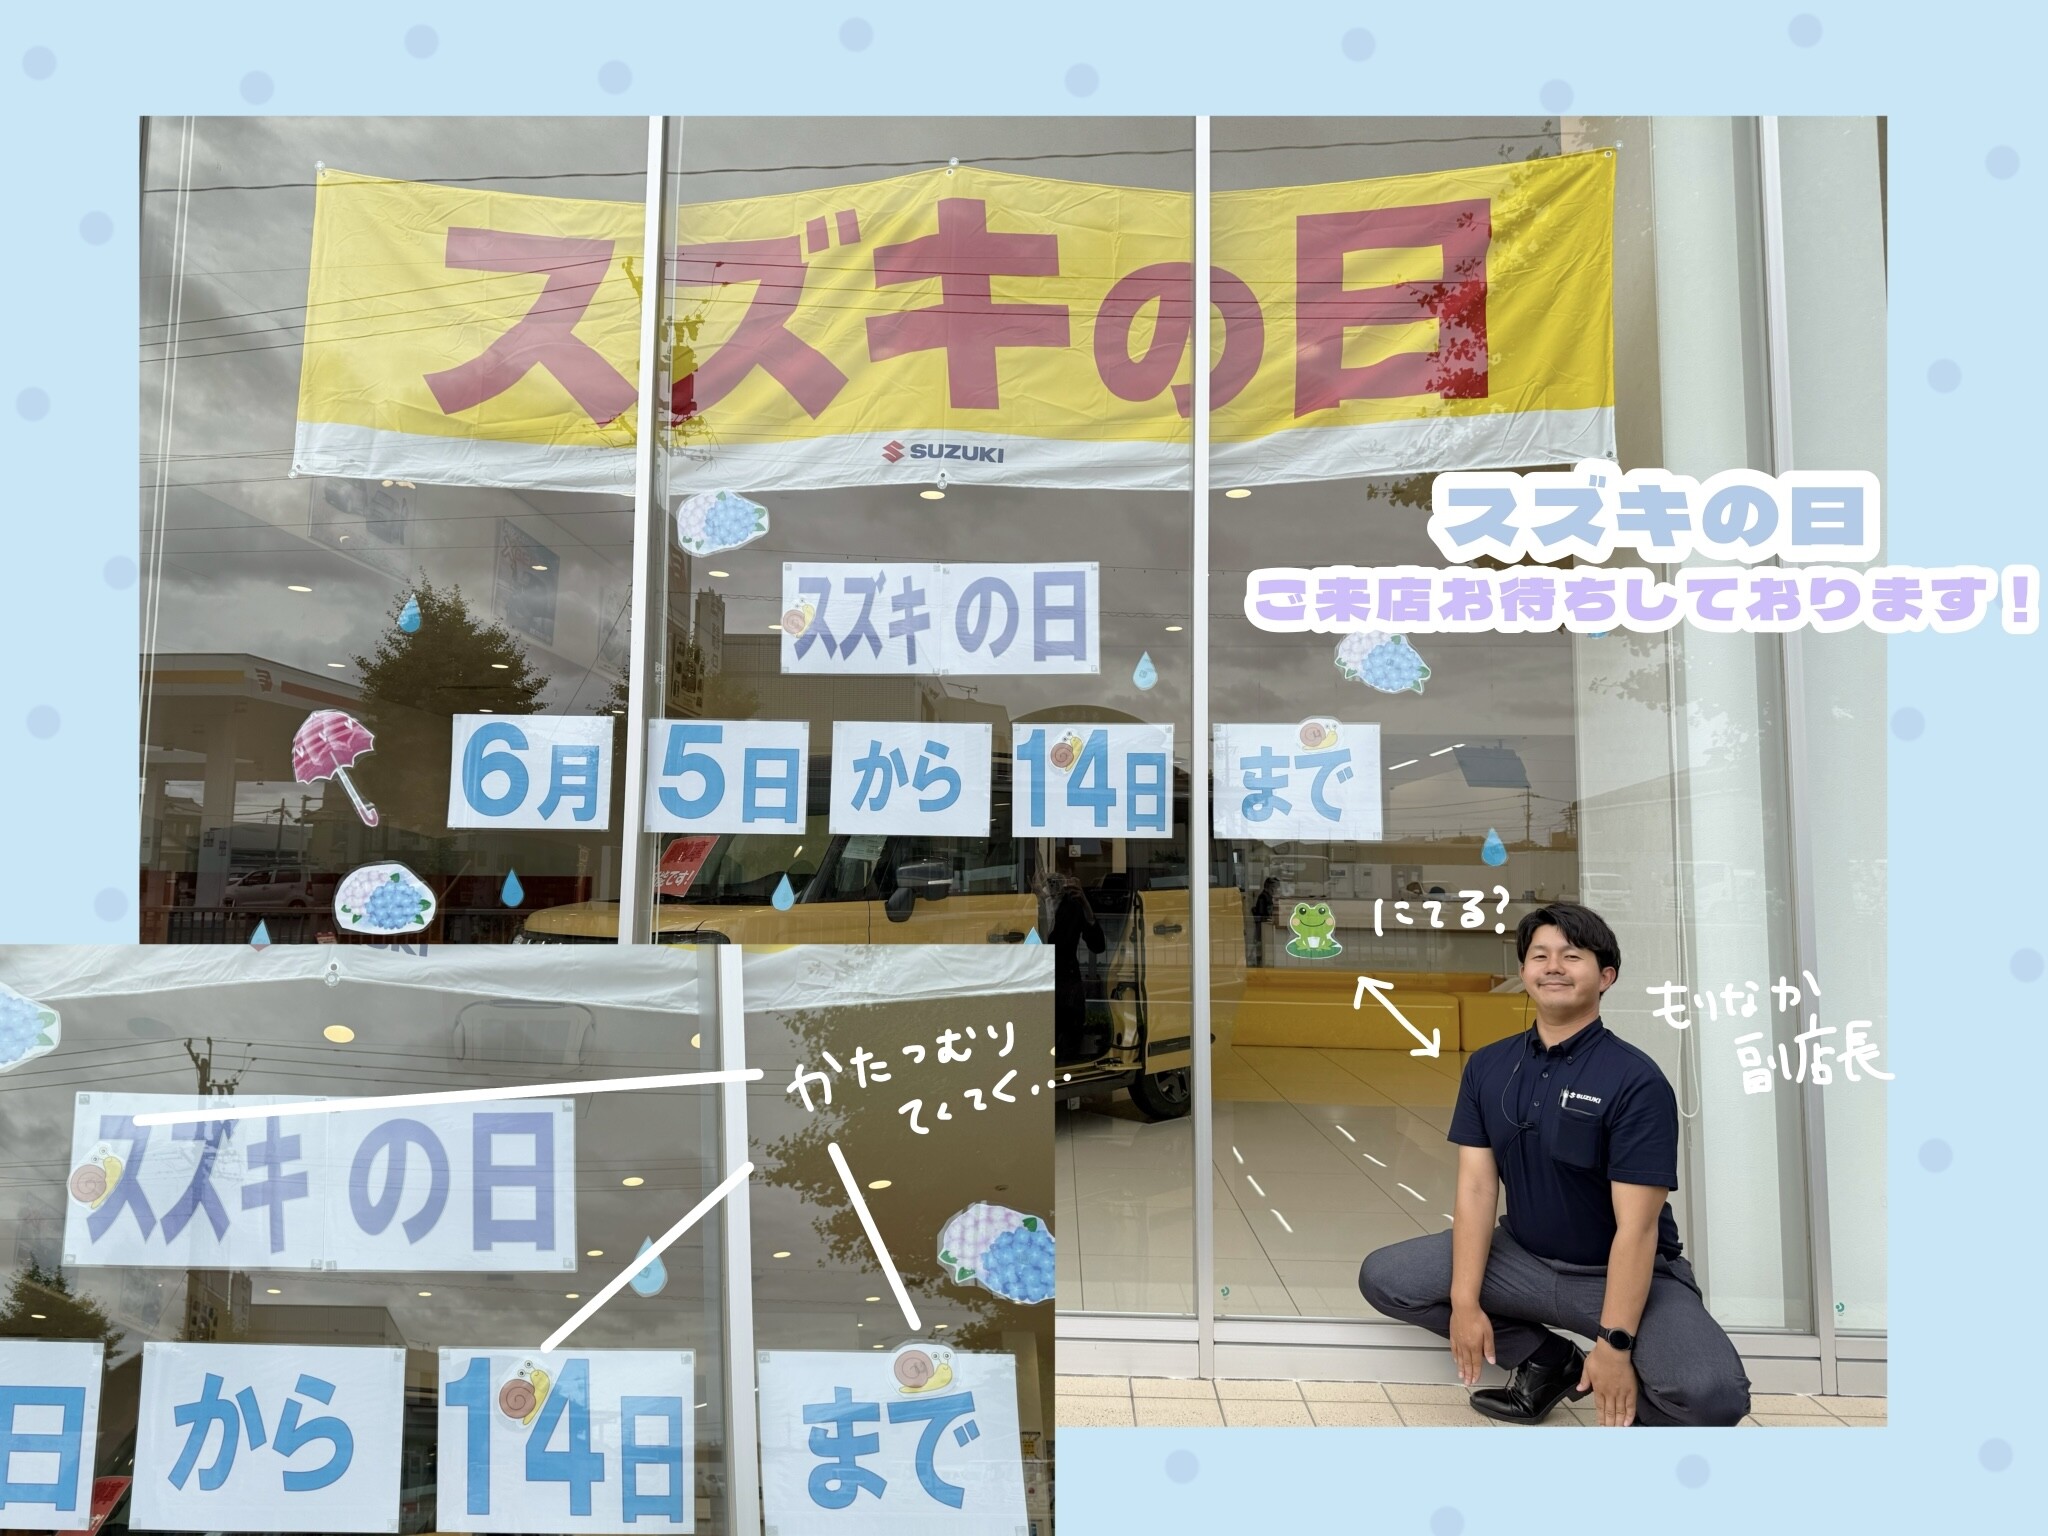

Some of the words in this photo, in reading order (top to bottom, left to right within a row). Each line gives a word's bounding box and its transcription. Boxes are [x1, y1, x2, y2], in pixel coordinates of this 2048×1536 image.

[423, 197, 1492, 428] スズキの日
[909, 443, 1005, 464] SUZUKI
[462, 721, 600, 822] 6月
[658, 723, 799, 824] 5日
[852, 738, 961, 812] から
[1240, 745, 1355, 823] まで
[1576, 1093, 1602, 1105] SUZUKI
[167, 1372, 355, 1493] から
[802, 1385, 981, 1511] まで
